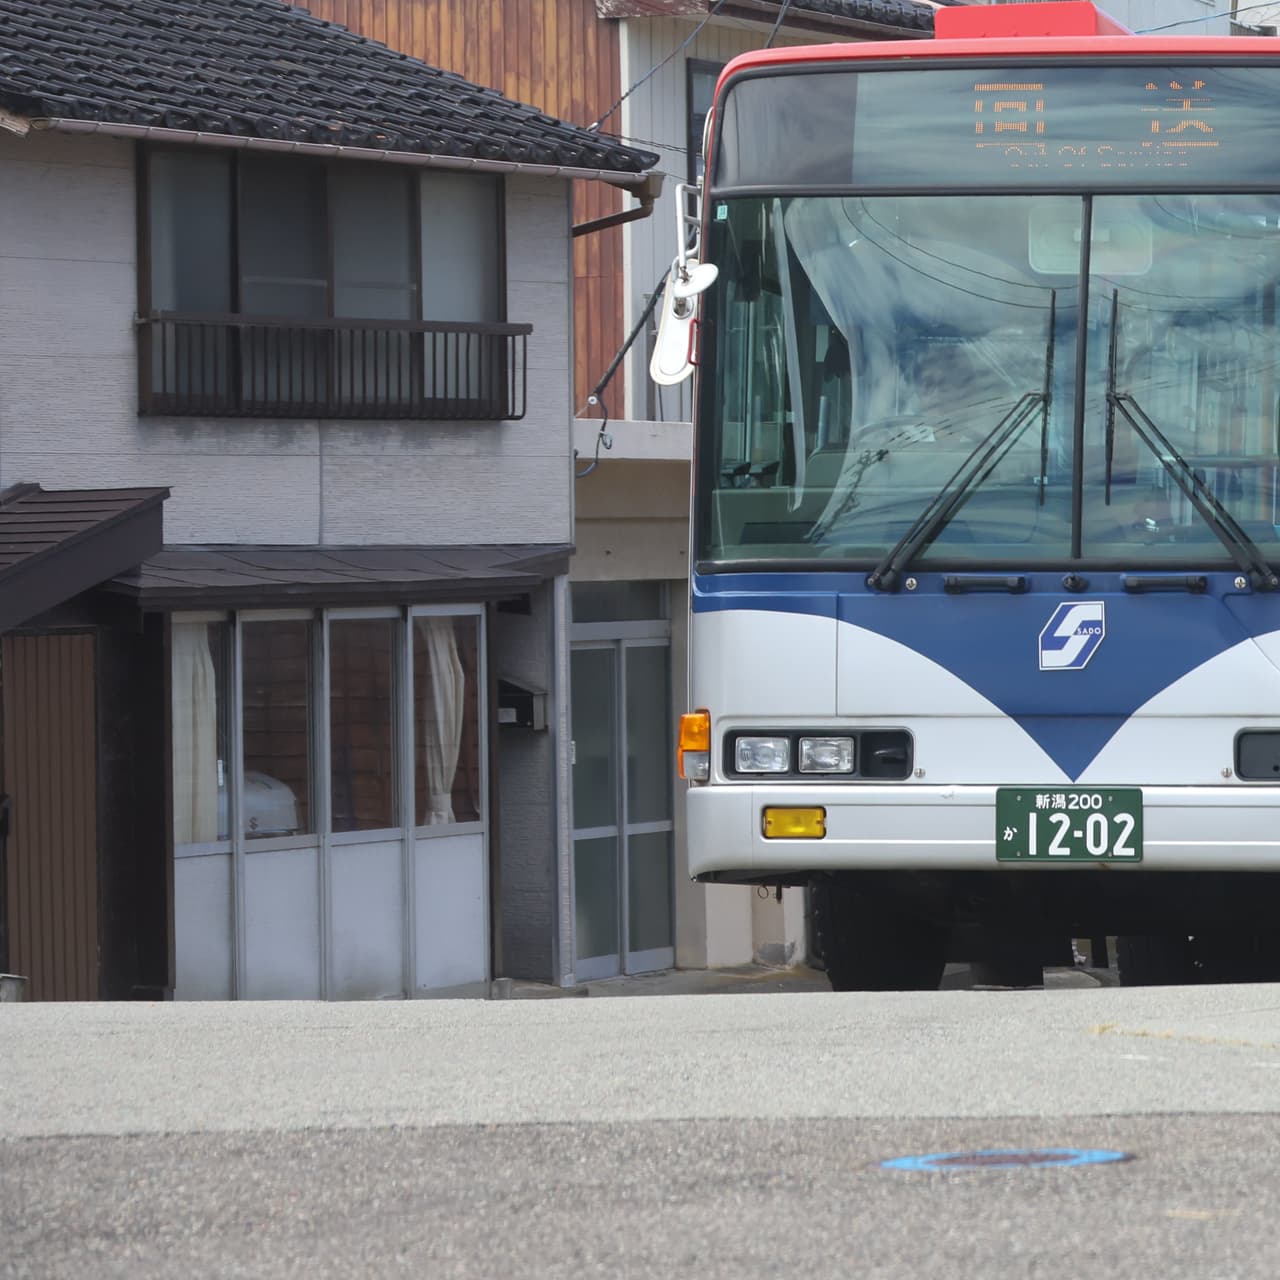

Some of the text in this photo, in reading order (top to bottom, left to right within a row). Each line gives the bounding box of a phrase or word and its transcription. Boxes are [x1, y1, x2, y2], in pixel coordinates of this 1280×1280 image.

[1077, 627, 1101, 635] SADO
[1035, 793, 1103, 810] 新潟200
[1003, 812, 1136, 856] か 12-02
